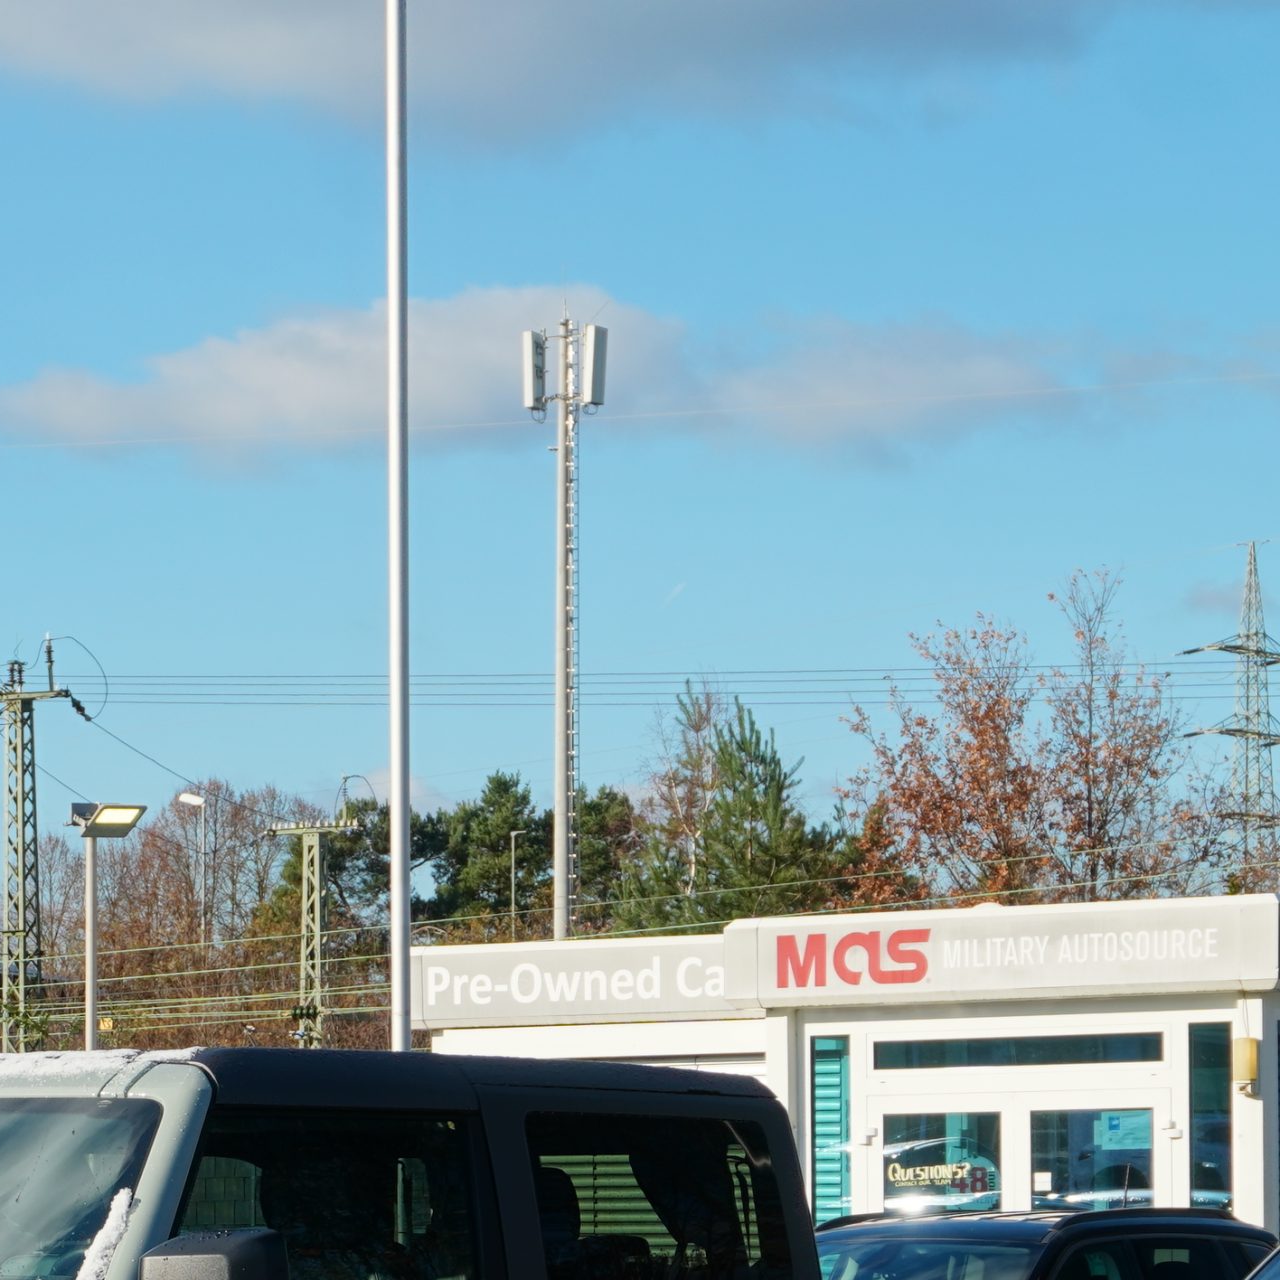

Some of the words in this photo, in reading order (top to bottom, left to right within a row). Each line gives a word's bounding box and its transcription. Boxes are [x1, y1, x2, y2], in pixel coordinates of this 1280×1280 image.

[942, 935, 1050, 969] MILITARY
[1057, 927, 1219, 964] AUTOSOURCE
[426, 955, 661, 1006] Pre-Owned
